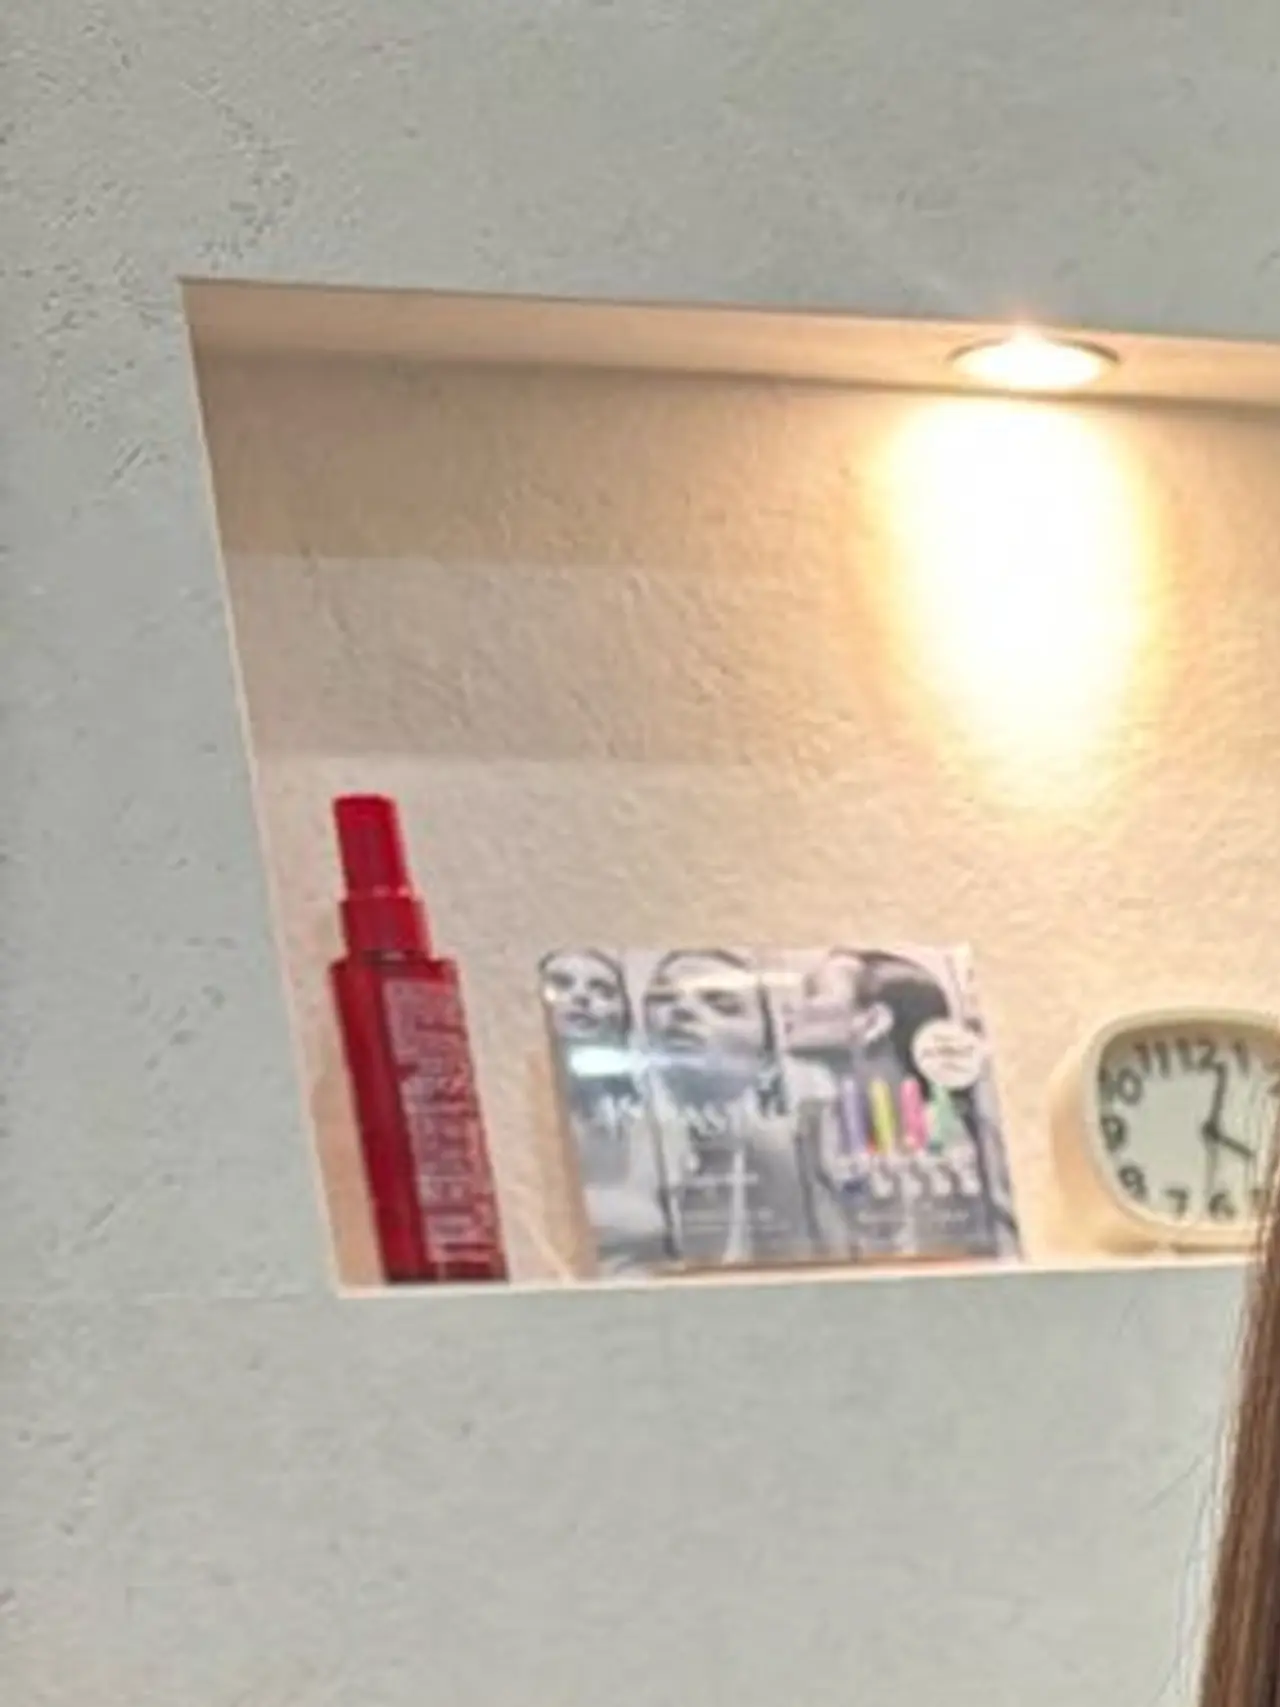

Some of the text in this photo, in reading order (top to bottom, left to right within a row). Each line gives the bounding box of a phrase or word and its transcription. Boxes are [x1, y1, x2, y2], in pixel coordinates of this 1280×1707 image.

[1134, 1040, 1169, 1077] 11
[1176, 1037, 1216, 1070] 12
[1098, 1067, 1142, 1105] 10
[1101, 1115, 1125, 1151] 9
[1164, 1187, 1189, 1218] 7
[1208, 1192, 1237, 1219] 6
